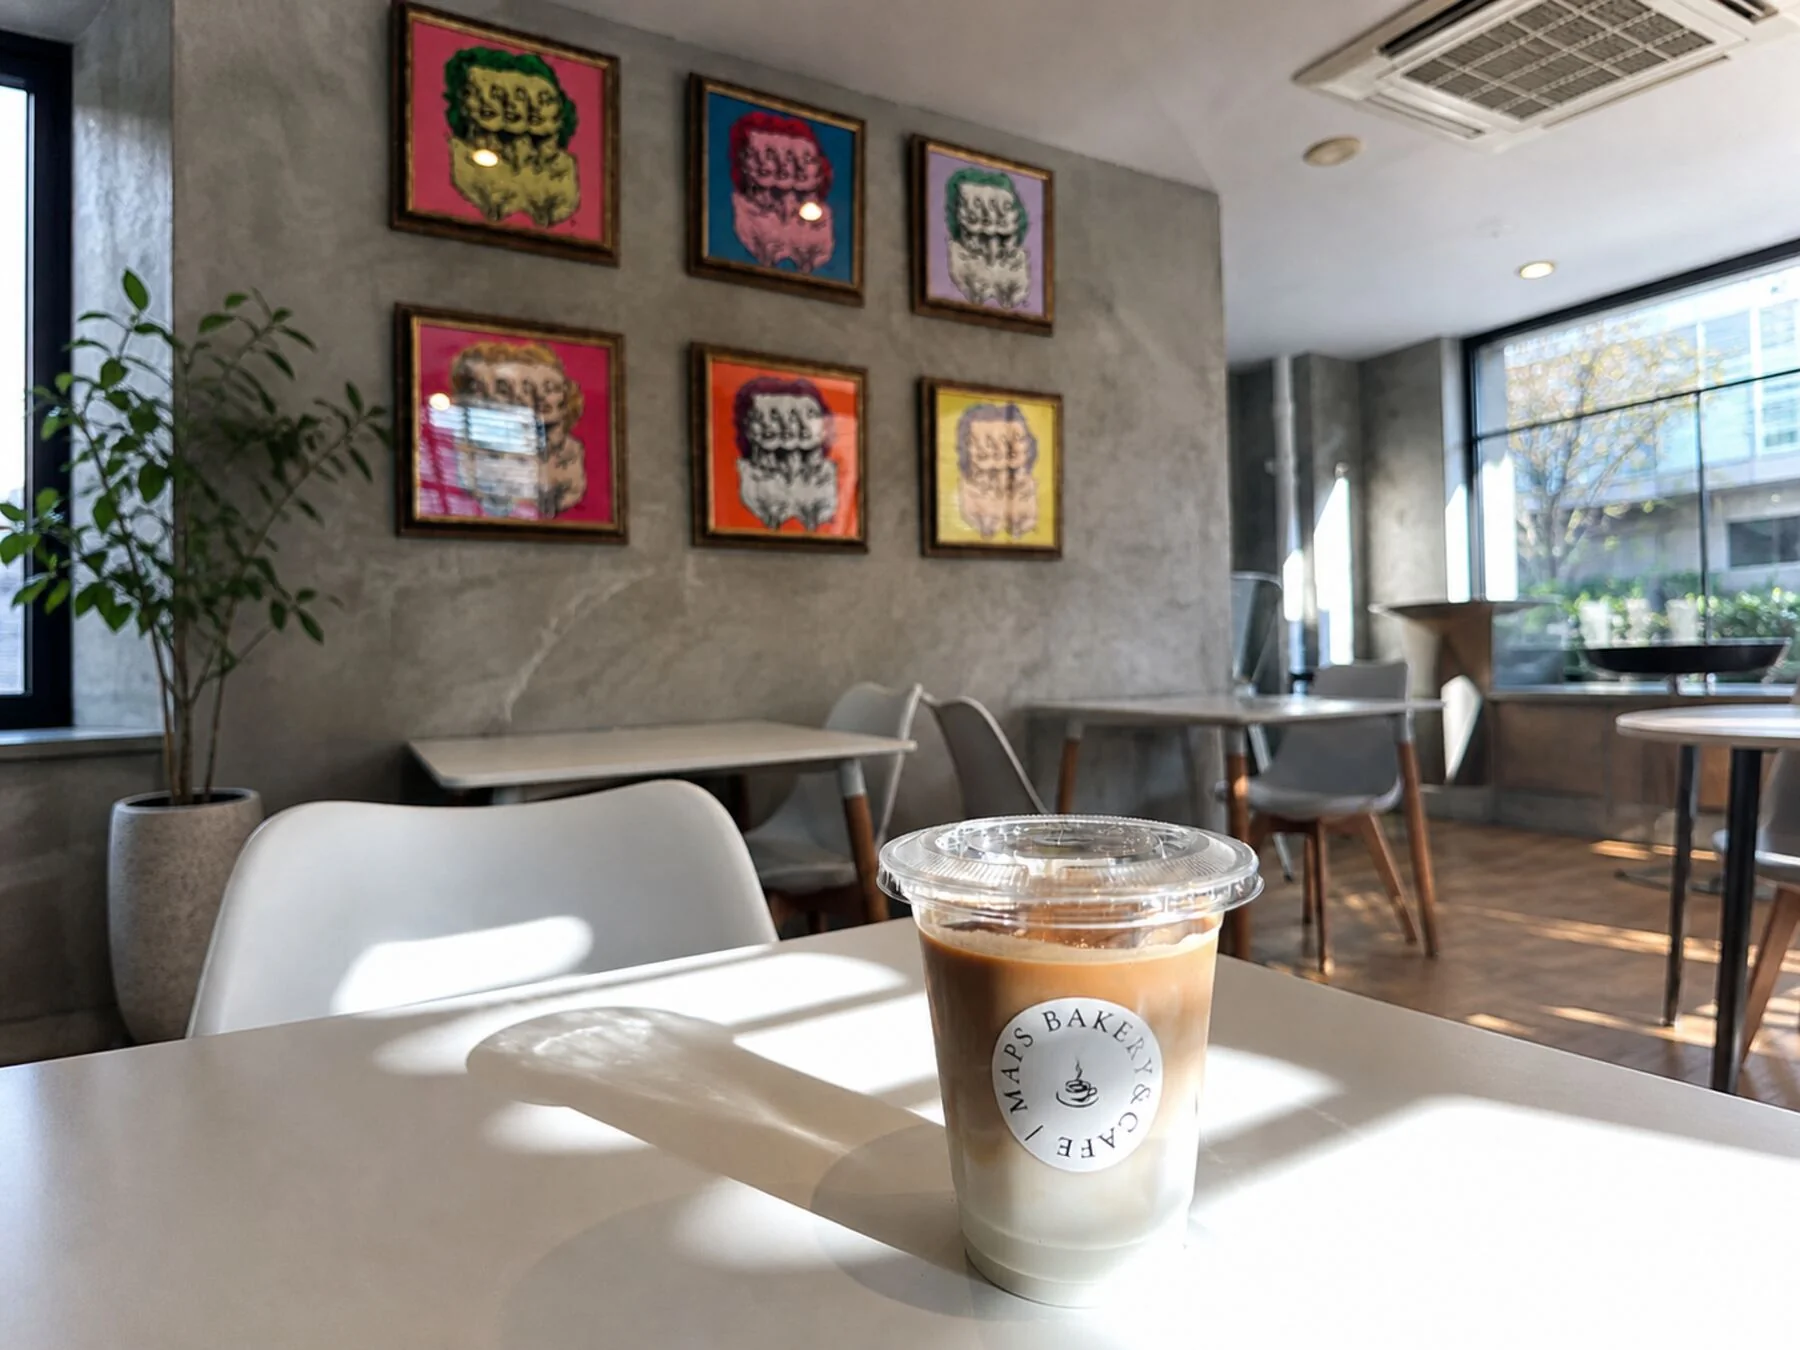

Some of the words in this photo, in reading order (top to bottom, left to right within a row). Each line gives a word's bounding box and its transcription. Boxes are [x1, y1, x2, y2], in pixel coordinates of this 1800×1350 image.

[1042, 1008, 1152, 1075] BAKERY
[1001, 1027, 1034, 1114] MAPS
[1130, 1083, 1151, 1104] &
[1056, 1111, 1138, 1159] CAFE
